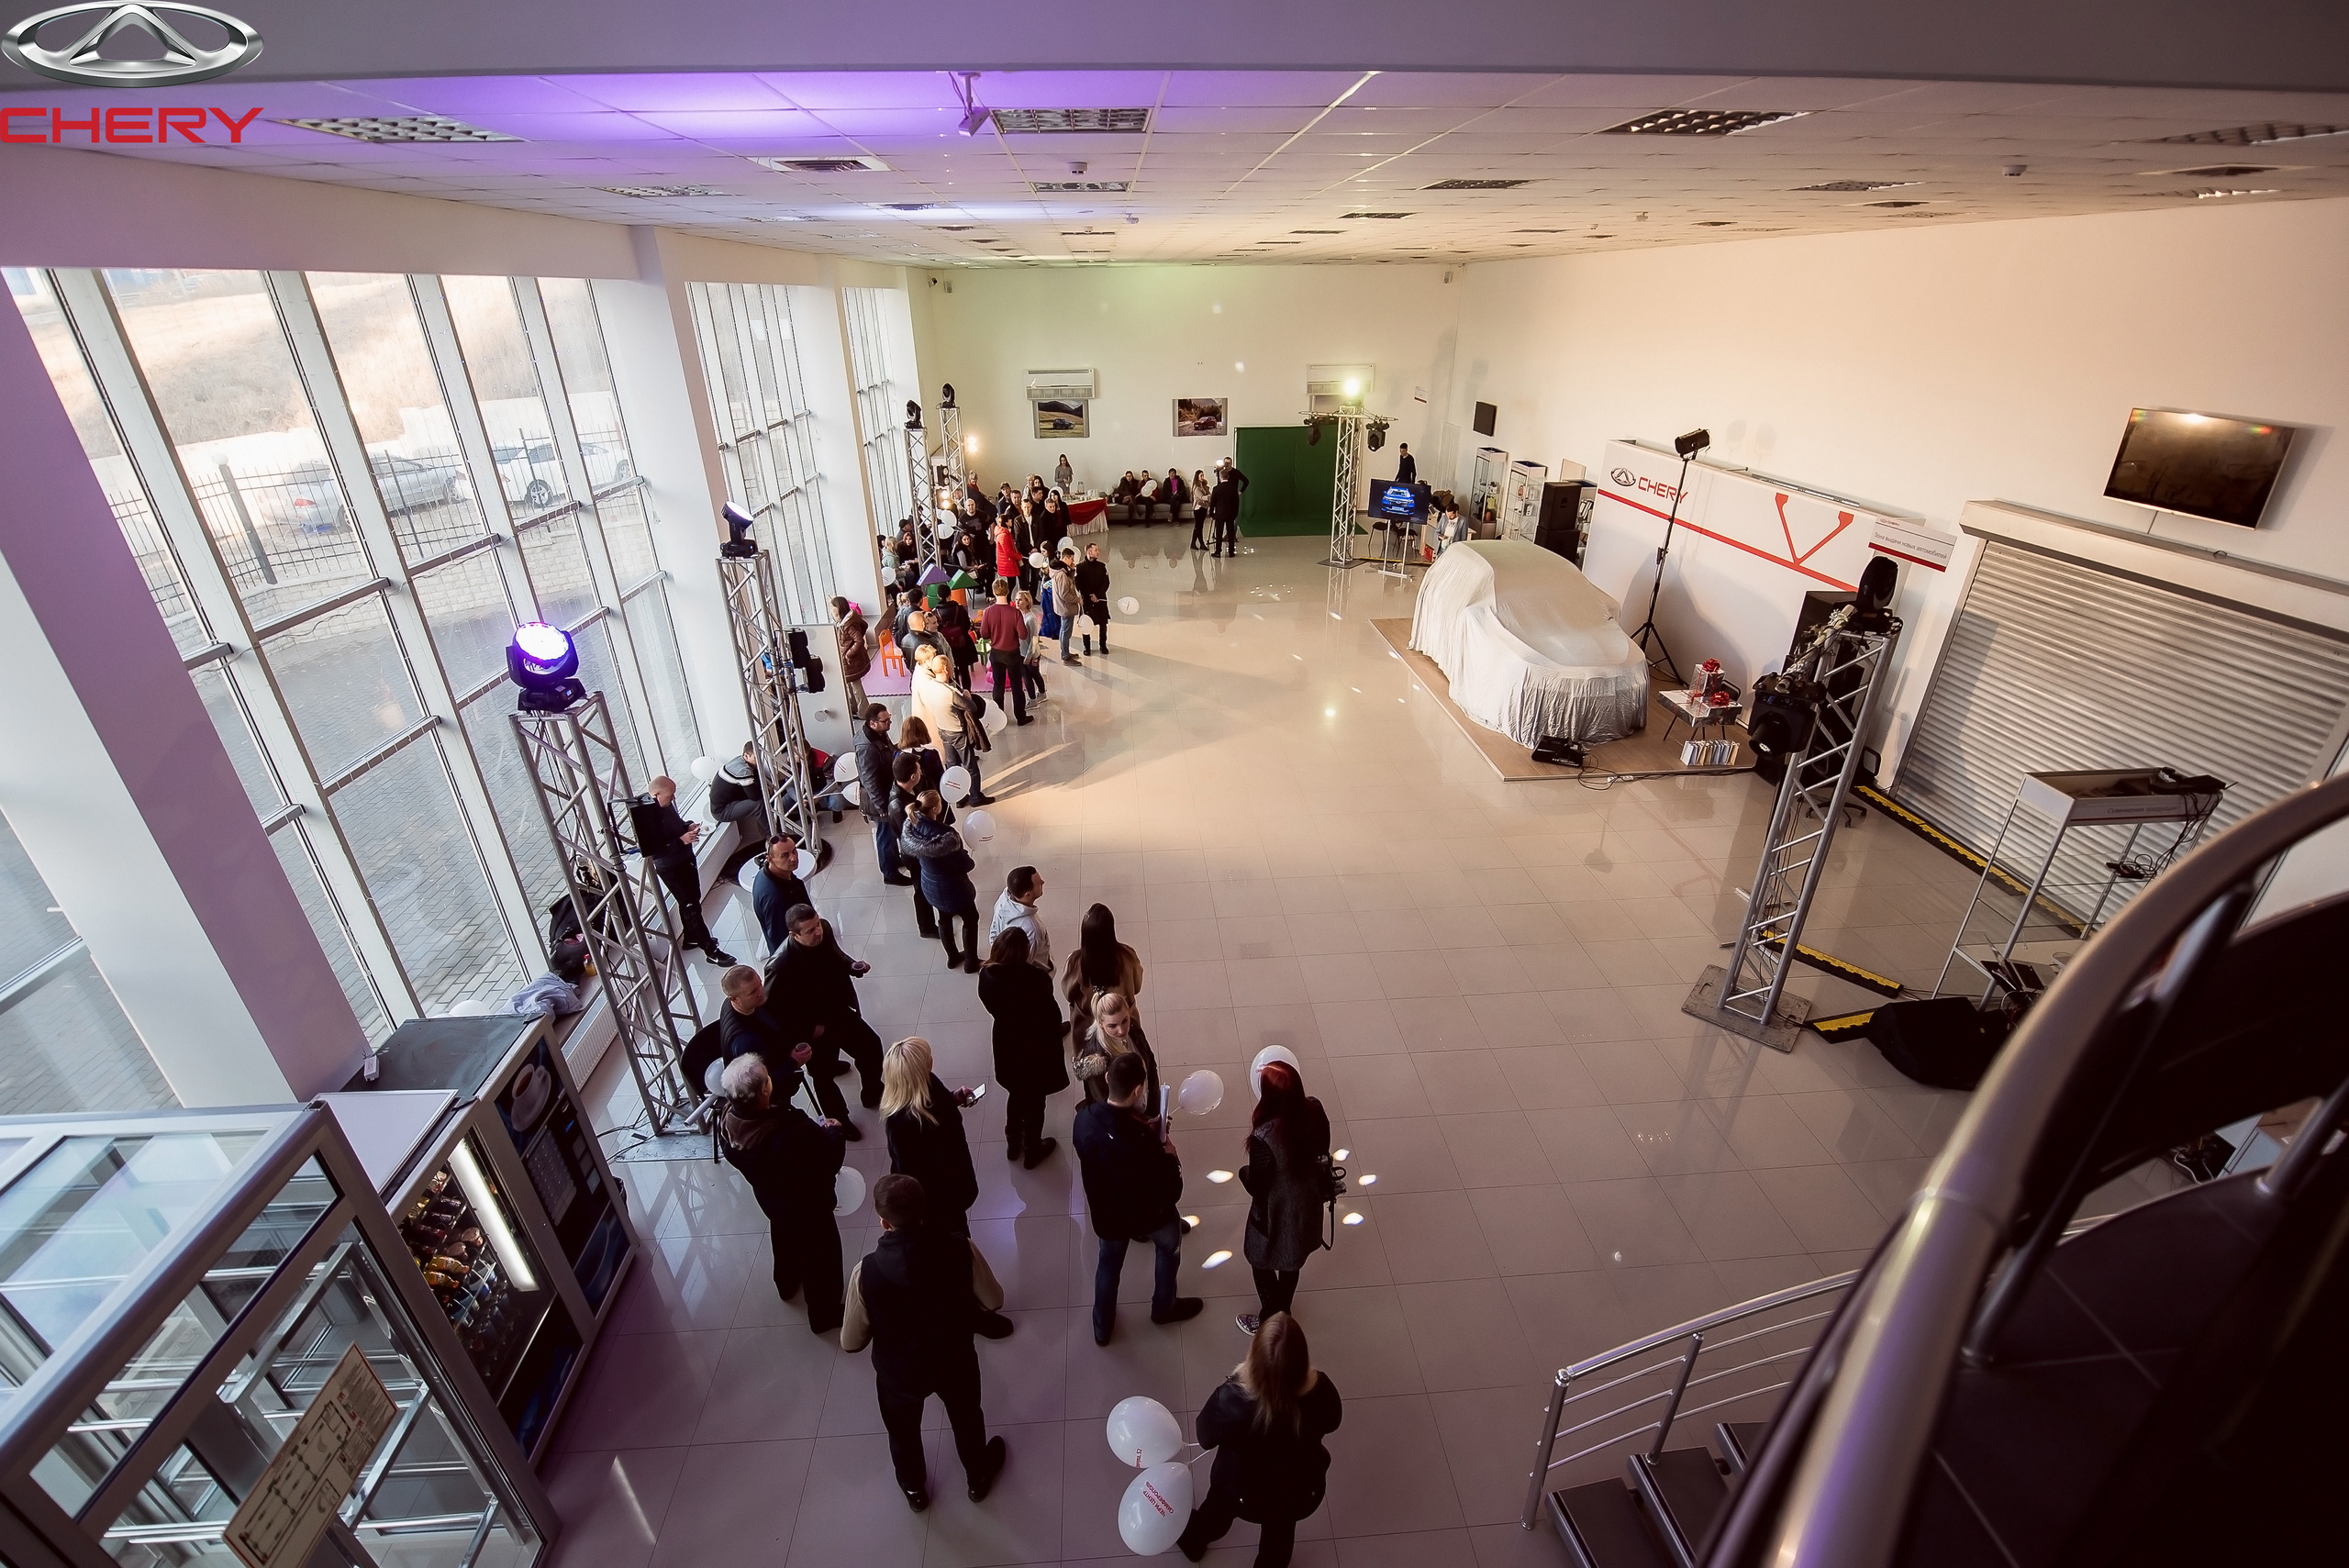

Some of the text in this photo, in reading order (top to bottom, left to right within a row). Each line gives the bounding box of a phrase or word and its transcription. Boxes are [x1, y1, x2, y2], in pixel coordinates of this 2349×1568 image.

[1638, 476, 1688, 504] CHERY
[1874, 531, 1885, 540] Зона
[1885, 537, 1901, 545] выдачи
[1916, 546, 1947, 560] автомобилей
[1142, 1490, 1166, 1518] ЧЕРИ ЦЕНТР
